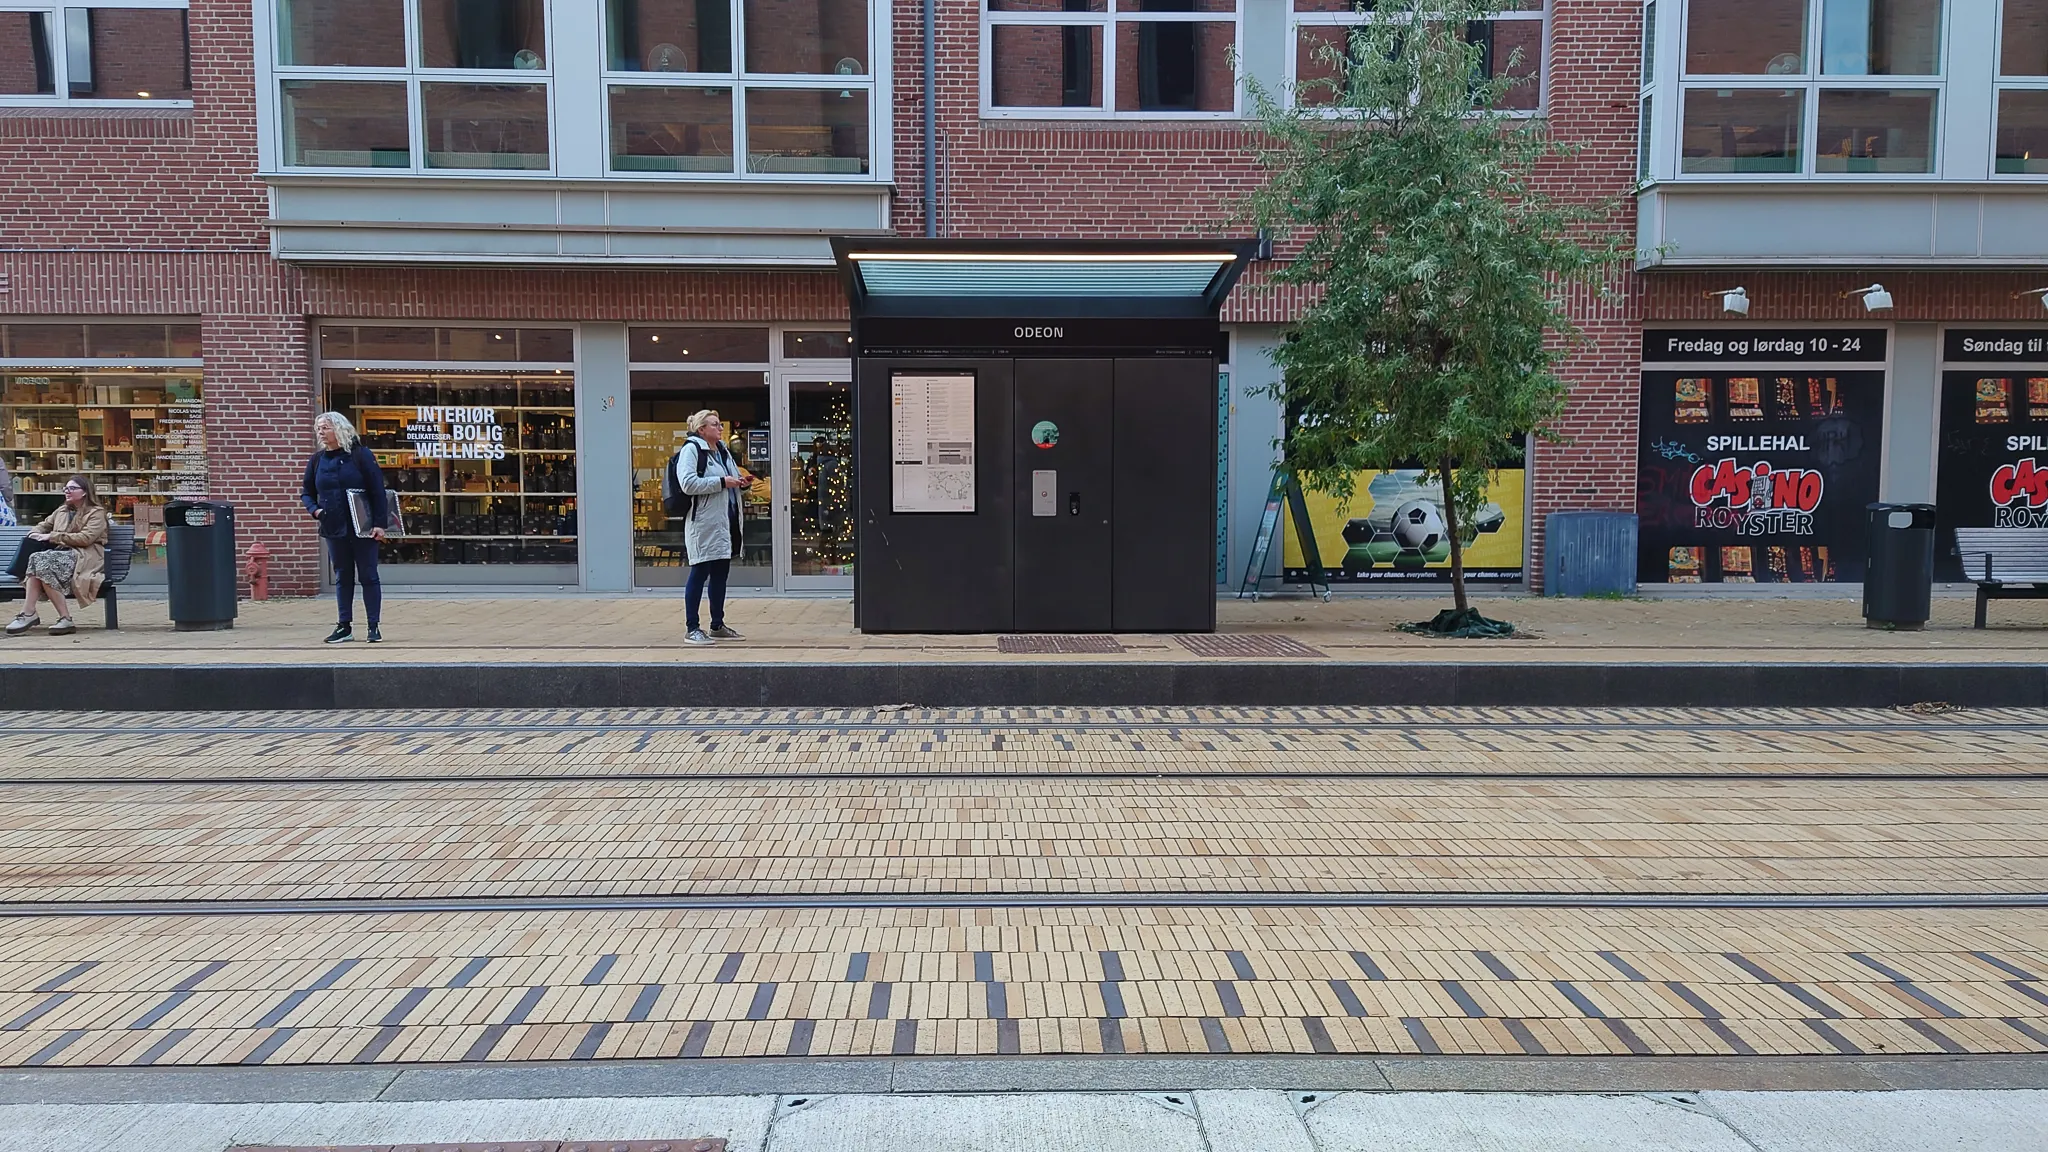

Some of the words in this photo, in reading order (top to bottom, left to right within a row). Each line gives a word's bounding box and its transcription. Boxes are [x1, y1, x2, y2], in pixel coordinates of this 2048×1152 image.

[1014, 326, 1063, 338] ODEON
[1668, 338, 1723, 355] Fredag
[1728, 341, 1749, 355] og
[1753, 338, 1804, 355] lørdag
[1809, 338, 1827, 351] 10
[1842, 338, 1861, 351] 24
[1963, 337, 2024, 355] Søndag
[2027, 338, 2043, 352] til
[417, 405, 495, 424] INTERIØR
[406, 424, 426, 432] KAFFE
[427, 424, 432, 432] &
[433, 424, 441, 432] TE
[453, 425, 503, 441] BOLIG
[416, 442, 505, 460] WELLNESS
[1706, 435, 1810, 451] SPILLEHAL
[2006, 435, 2048, 451] SPIL
[1694, 507, 1813, 535] ROYSTER
